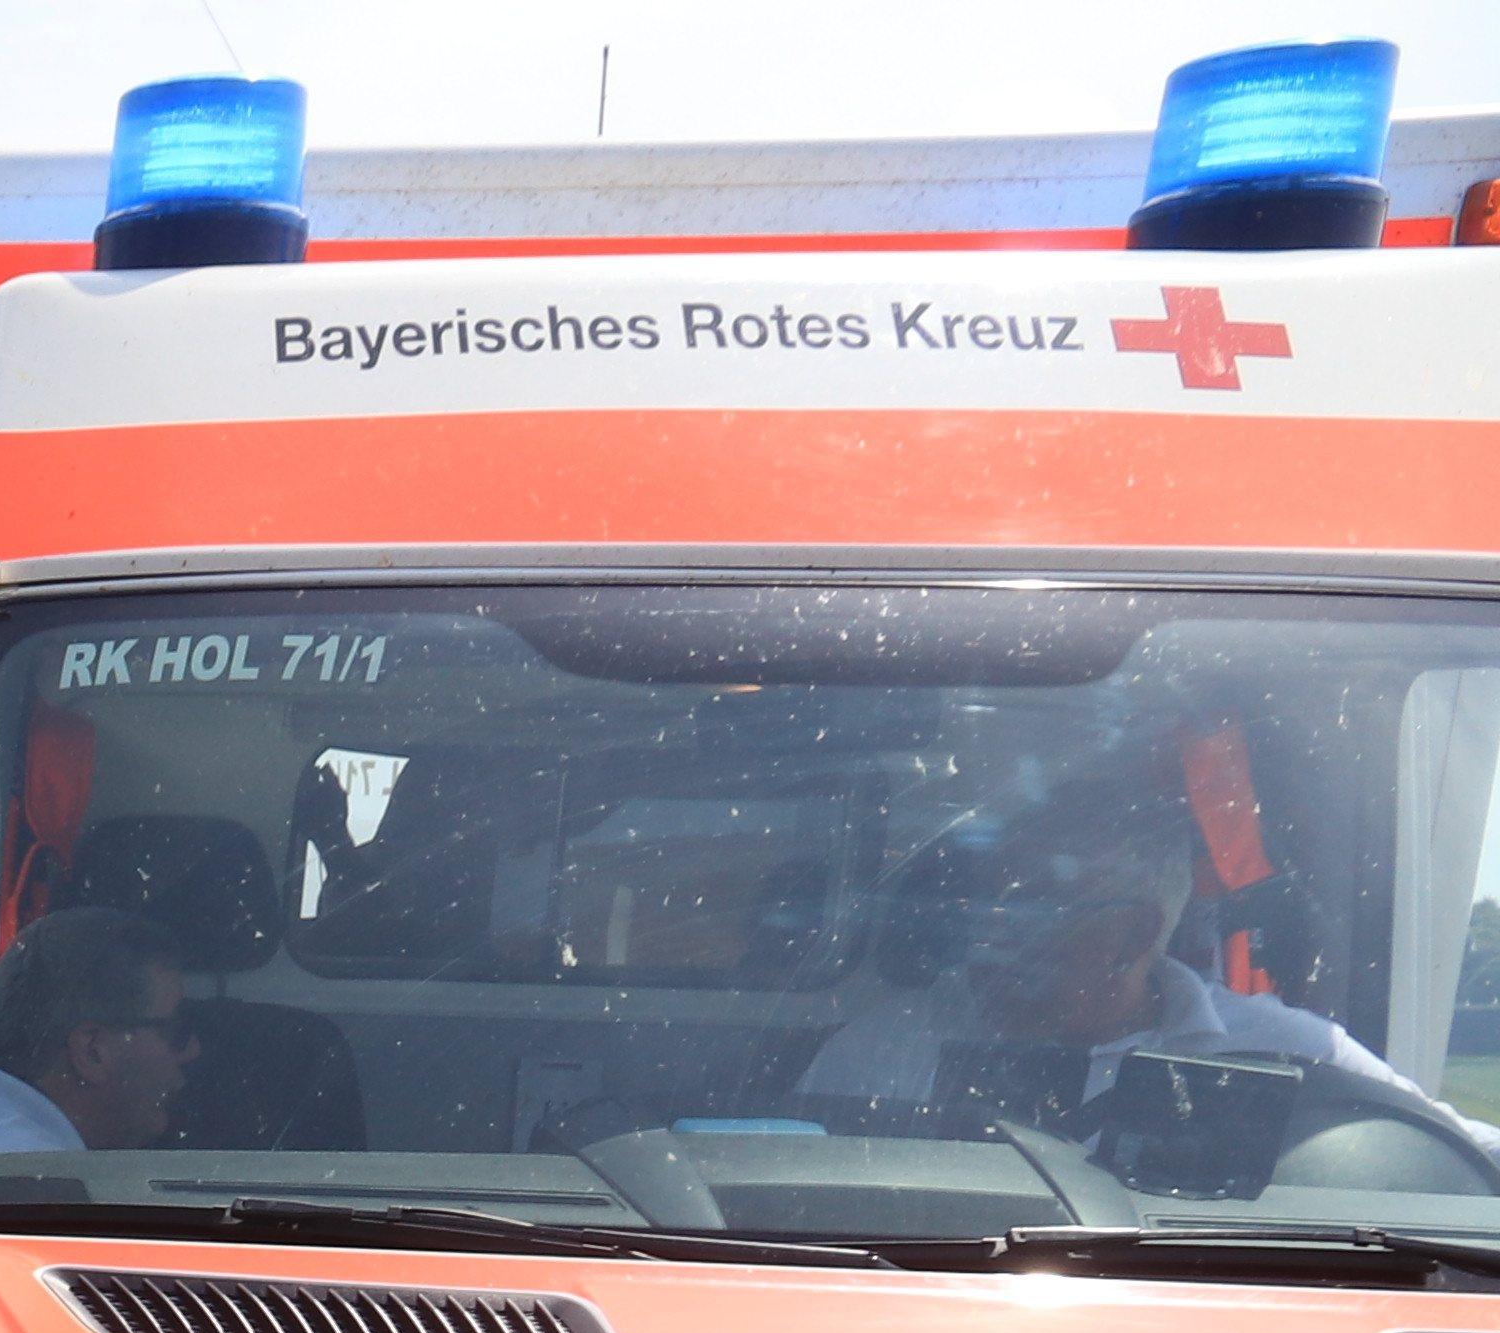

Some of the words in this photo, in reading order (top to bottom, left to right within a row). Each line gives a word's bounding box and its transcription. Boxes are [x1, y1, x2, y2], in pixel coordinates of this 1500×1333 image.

[274, 305, 661, 369] Bayerisches
[681, 302, 871, 350] Rotes
[889, 302, 1085, 354] Kreuz
[58, 638, 139, 689] RK
[149, 634, 260, 683] HOL
[281, 634, 387, 683] 71/1
